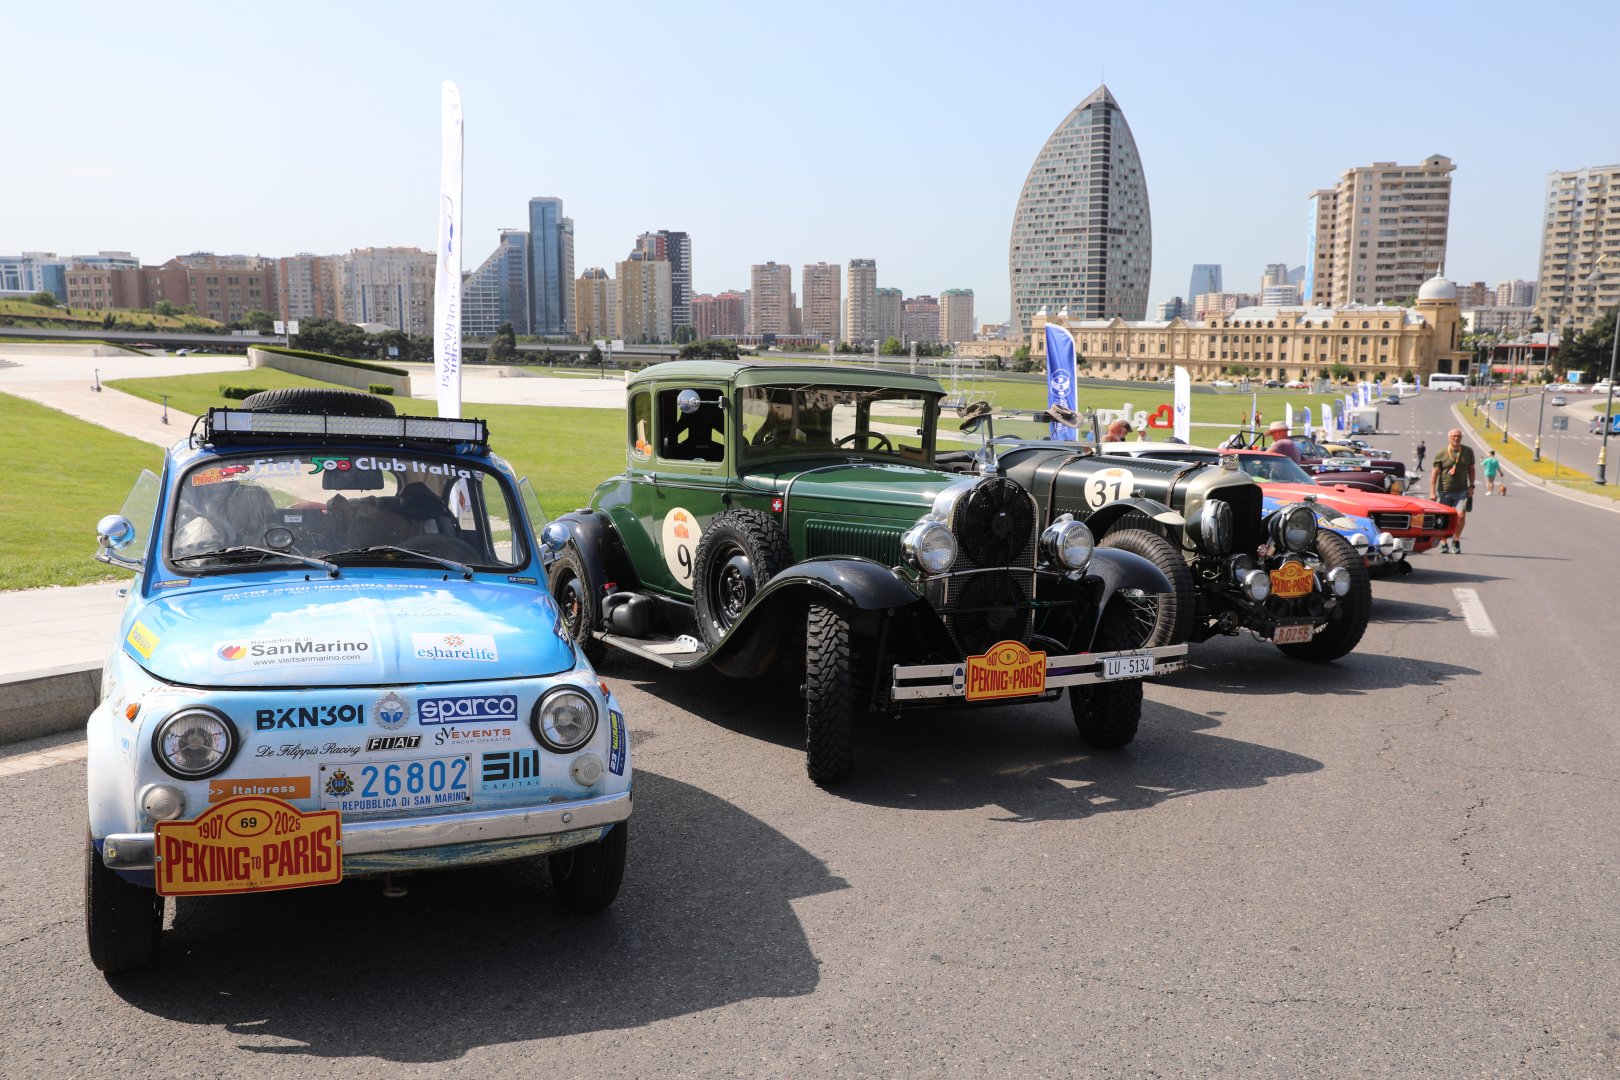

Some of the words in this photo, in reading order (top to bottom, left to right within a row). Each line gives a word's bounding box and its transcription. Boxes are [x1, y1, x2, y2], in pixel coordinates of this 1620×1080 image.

[253, 457, 302, 473] Fiat
[308, 457, 352, 475] 500
[355, 456, 407, 472] Club
[412, 460, 471, 479] Italia
[1091, 479, 1122, 508] 31
[677, 543, 692, 580] 9
[250, 636, 301, 645] Repubblica
[250, 640, 369, 657] SanMarino
[253, 653, 361, 666] www.visitsanmarino.com
[417, 646, 495, 660] esharelife
[1006, 653, 1011, 661] 9
[970, 663, 1008, 692] PEKING
[1012, 659, 1043, 690] PARIS
[1108, 660, 1121, 675] LU
[1129, 658, 1150, 674] 5134
[256, 704, 364, 731] BKN301
[420, 697, 516, 723] sparco
[451, 728, 512, 739] EVENTS
[255, 744, 274, 758] De
[276, 743, 319, 759] Filippis
[319, 742, 361, 757] Racing
[370, 736, 420, 750] FIAT
[361, 758, 467, 798] 26802
[232, 784, 296, 795] Italpress
[342, 797, 398, 811] REPUBBLICA
[401, 796, 410, 806] DI
[414, 795, 431, 806] SAN
[434, 791, 467, 803] MARINO
[197, 814, 224, 840] 1907
[240, 817, 258, 829] 69
[274, 810, 301, 836] 2025
[165, 834, 251, 883] PEKING
[250, 856, 262, 870] TO
[263, 825, 332, 879] PARIS
